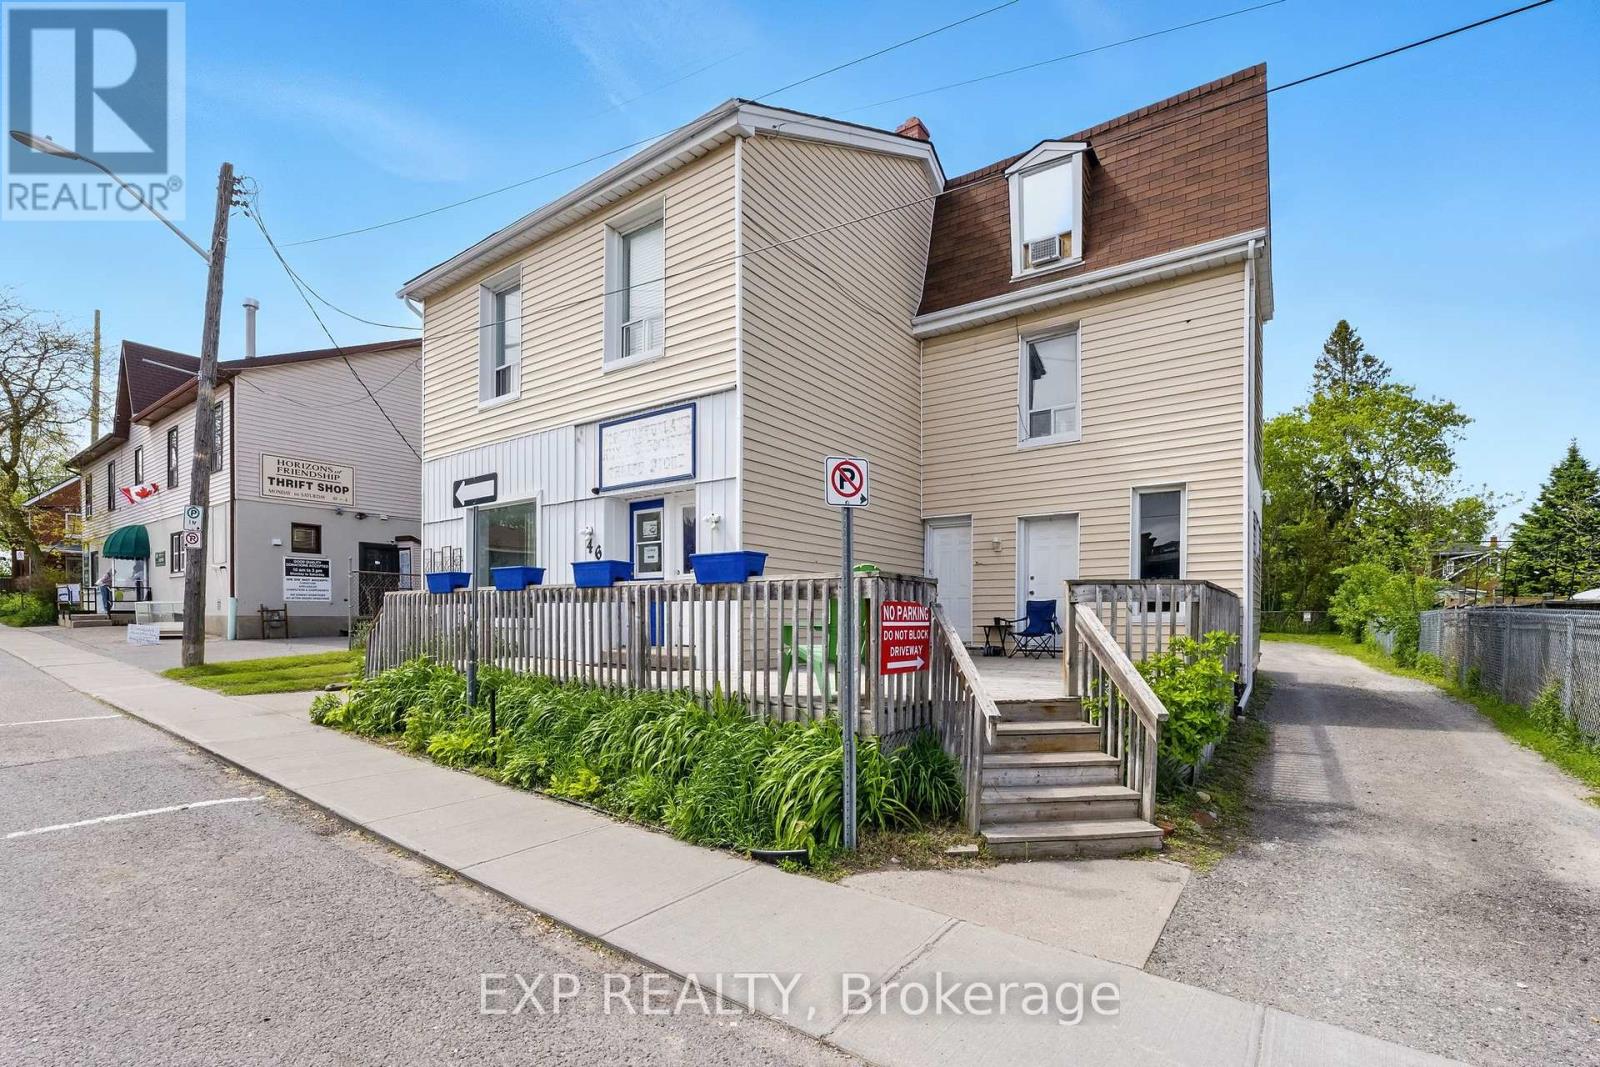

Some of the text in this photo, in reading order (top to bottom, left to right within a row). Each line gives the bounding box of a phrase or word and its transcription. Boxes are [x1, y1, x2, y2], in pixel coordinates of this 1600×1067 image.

[277, 459, 334, 473] HORIZONS
[277, 467, 340, 480] FRIENDSHIP
[267, 477, 349, 495] THRIFT SHOP
[587, 538, 602, 560] 46
[883, 605, 929, 621] NO PARKING
[883, 629, 929, 640] DO NOT BLOCK
[890, 645, 923, 657] DRIVEWAY
